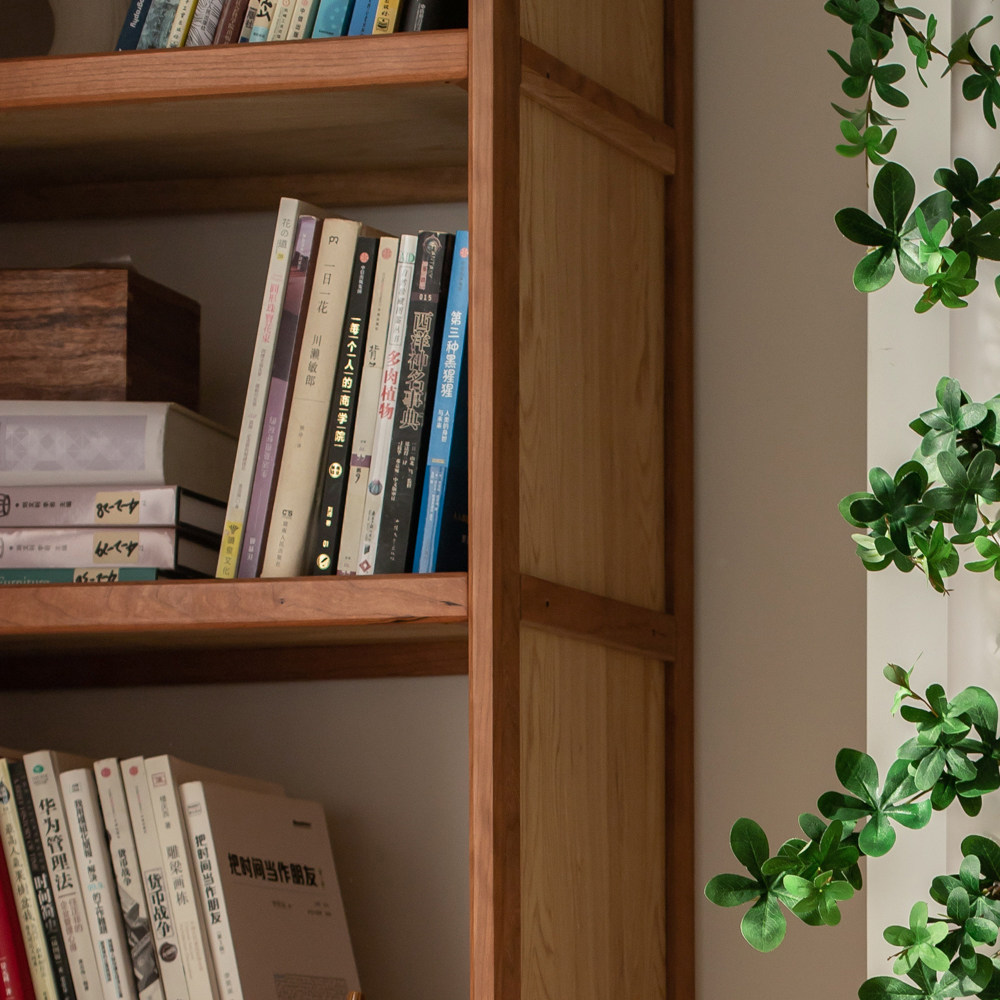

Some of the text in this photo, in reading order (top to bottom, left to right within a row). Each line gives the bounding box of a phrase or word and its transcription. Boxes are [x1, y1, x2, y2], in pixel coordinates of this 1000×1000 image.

[318, 264, 335, 314] 一日一花
[379, 350, 401, 421] 多肉植物
[399, 311, 434, 431] 西洋神名事典
[441, 310, 463, 398] 第三种黑猩猩
[39, 797, 74, 892] 华为管理法
[118, 848, 132, 887] 货币战争
[166, 844, 189, 906] 雕梁画栋
[195, 833, 222, 924] 把时间当作朋友
[228, 852, 318, 887] 把时间当作朋友
[147, 872, 171, 938] 货币战争
